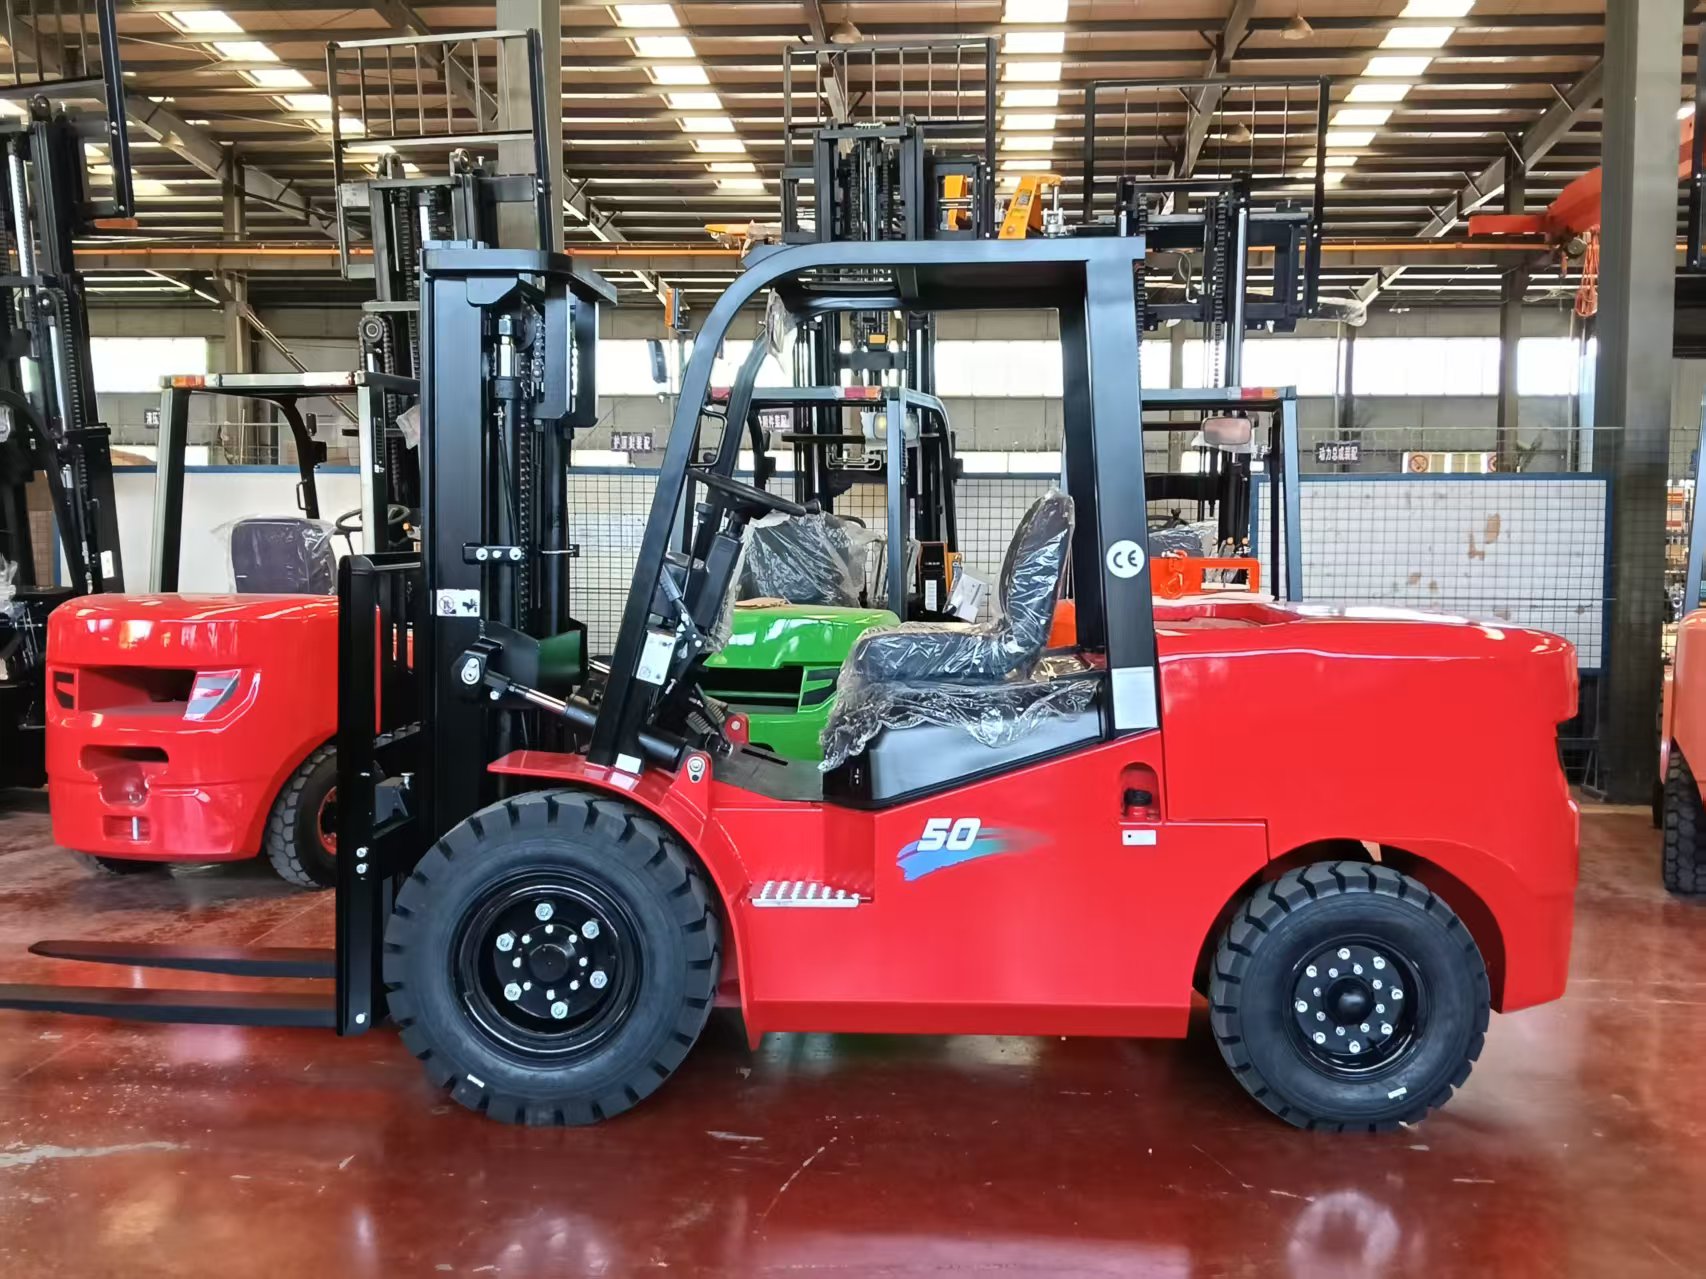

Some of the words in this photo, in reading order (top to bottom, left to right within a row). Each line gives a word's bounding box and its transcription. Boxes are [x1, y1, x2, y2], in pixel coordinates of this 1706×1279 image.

[1319, 446, 1358, 461] 动力总成装配
[1113, 549, 1138, 569] CE
[917, 817, 981, 852] 50
